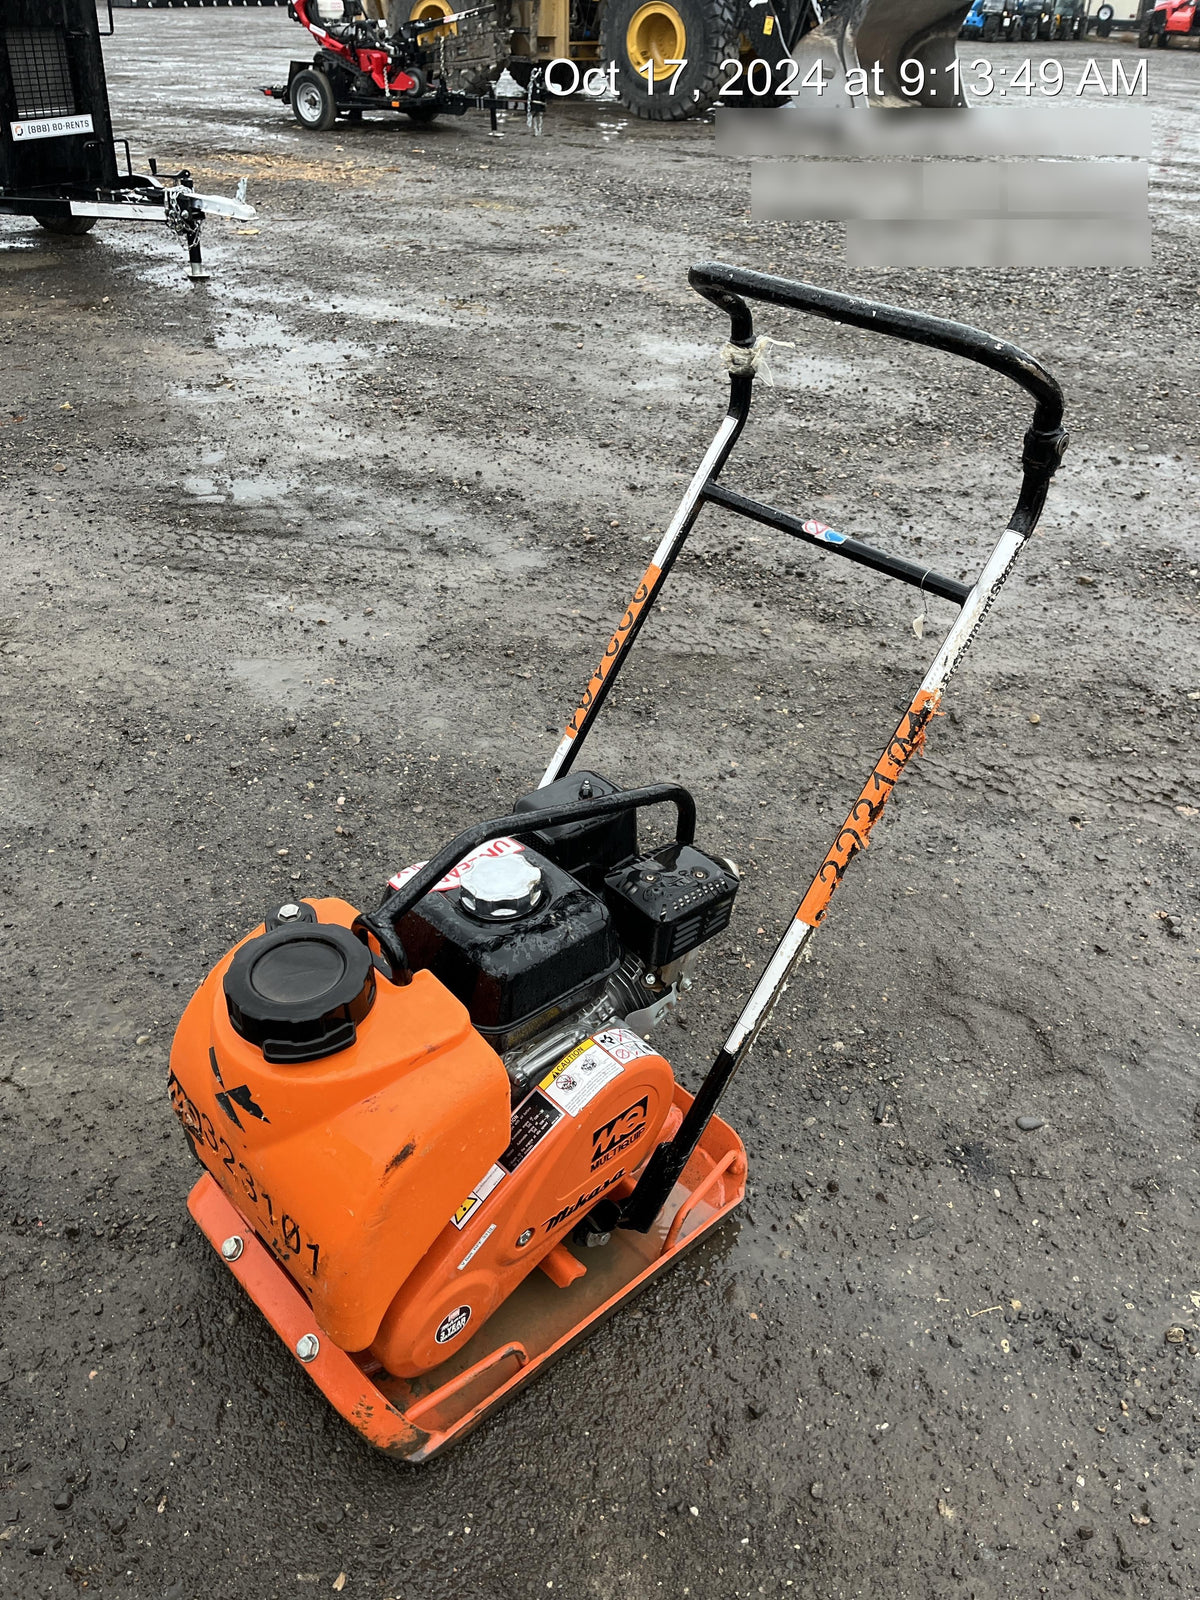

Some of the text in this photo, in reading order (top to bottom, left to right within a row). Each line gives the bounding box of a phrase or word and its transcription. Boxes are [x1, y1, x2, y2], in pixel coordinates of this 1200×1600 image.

[27, 119, 89, 134] (888) 80-RENTS
[556, 1046, 584, 1073] CAUTION
[590, 1127, 647, 1173] MULTIQUIP
[202, 1112, 320, 1276] 323101
